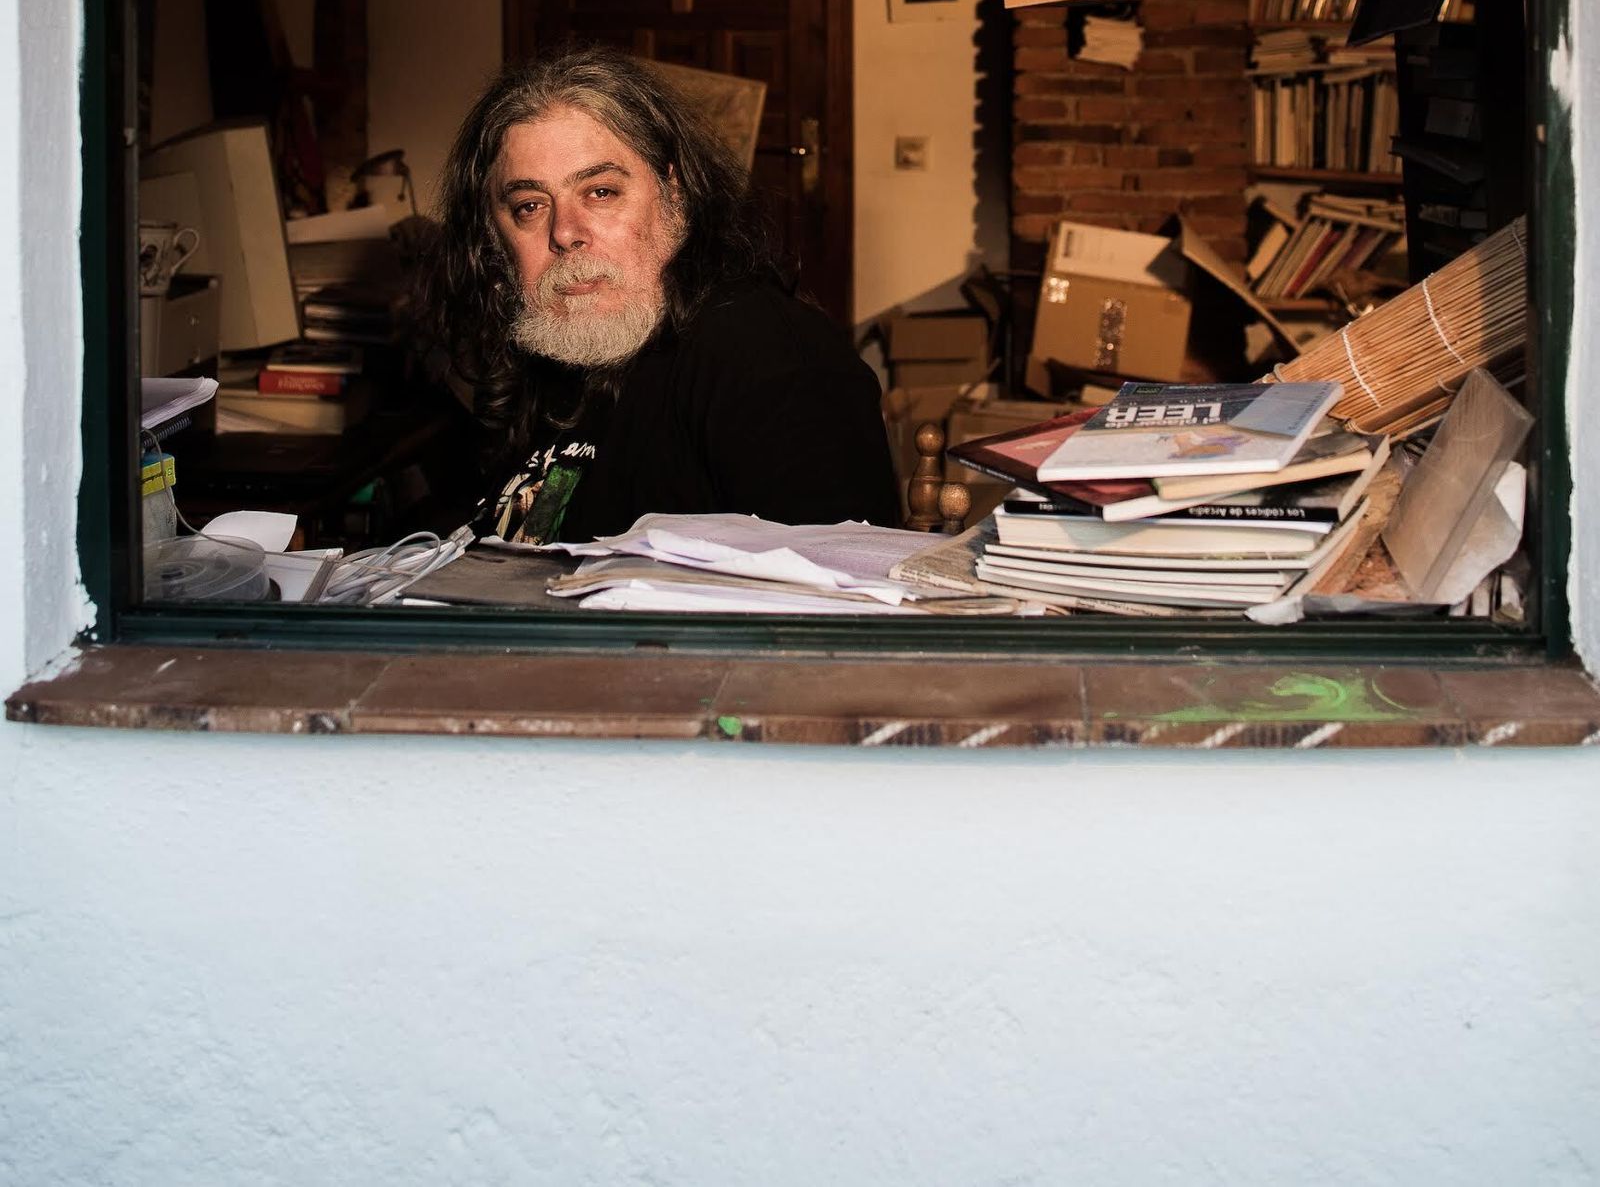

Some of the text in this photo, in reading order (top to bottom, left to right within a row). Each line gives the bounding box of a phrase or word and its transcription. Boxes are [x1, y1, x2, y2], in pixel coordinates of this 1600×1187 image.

[1105, 403, 1223, 422] LEER
[1188, 507, 1227, 517] Arcadia
[1229, 507, 1243, 518] de
[1286, 508, 1305, 518] Los
